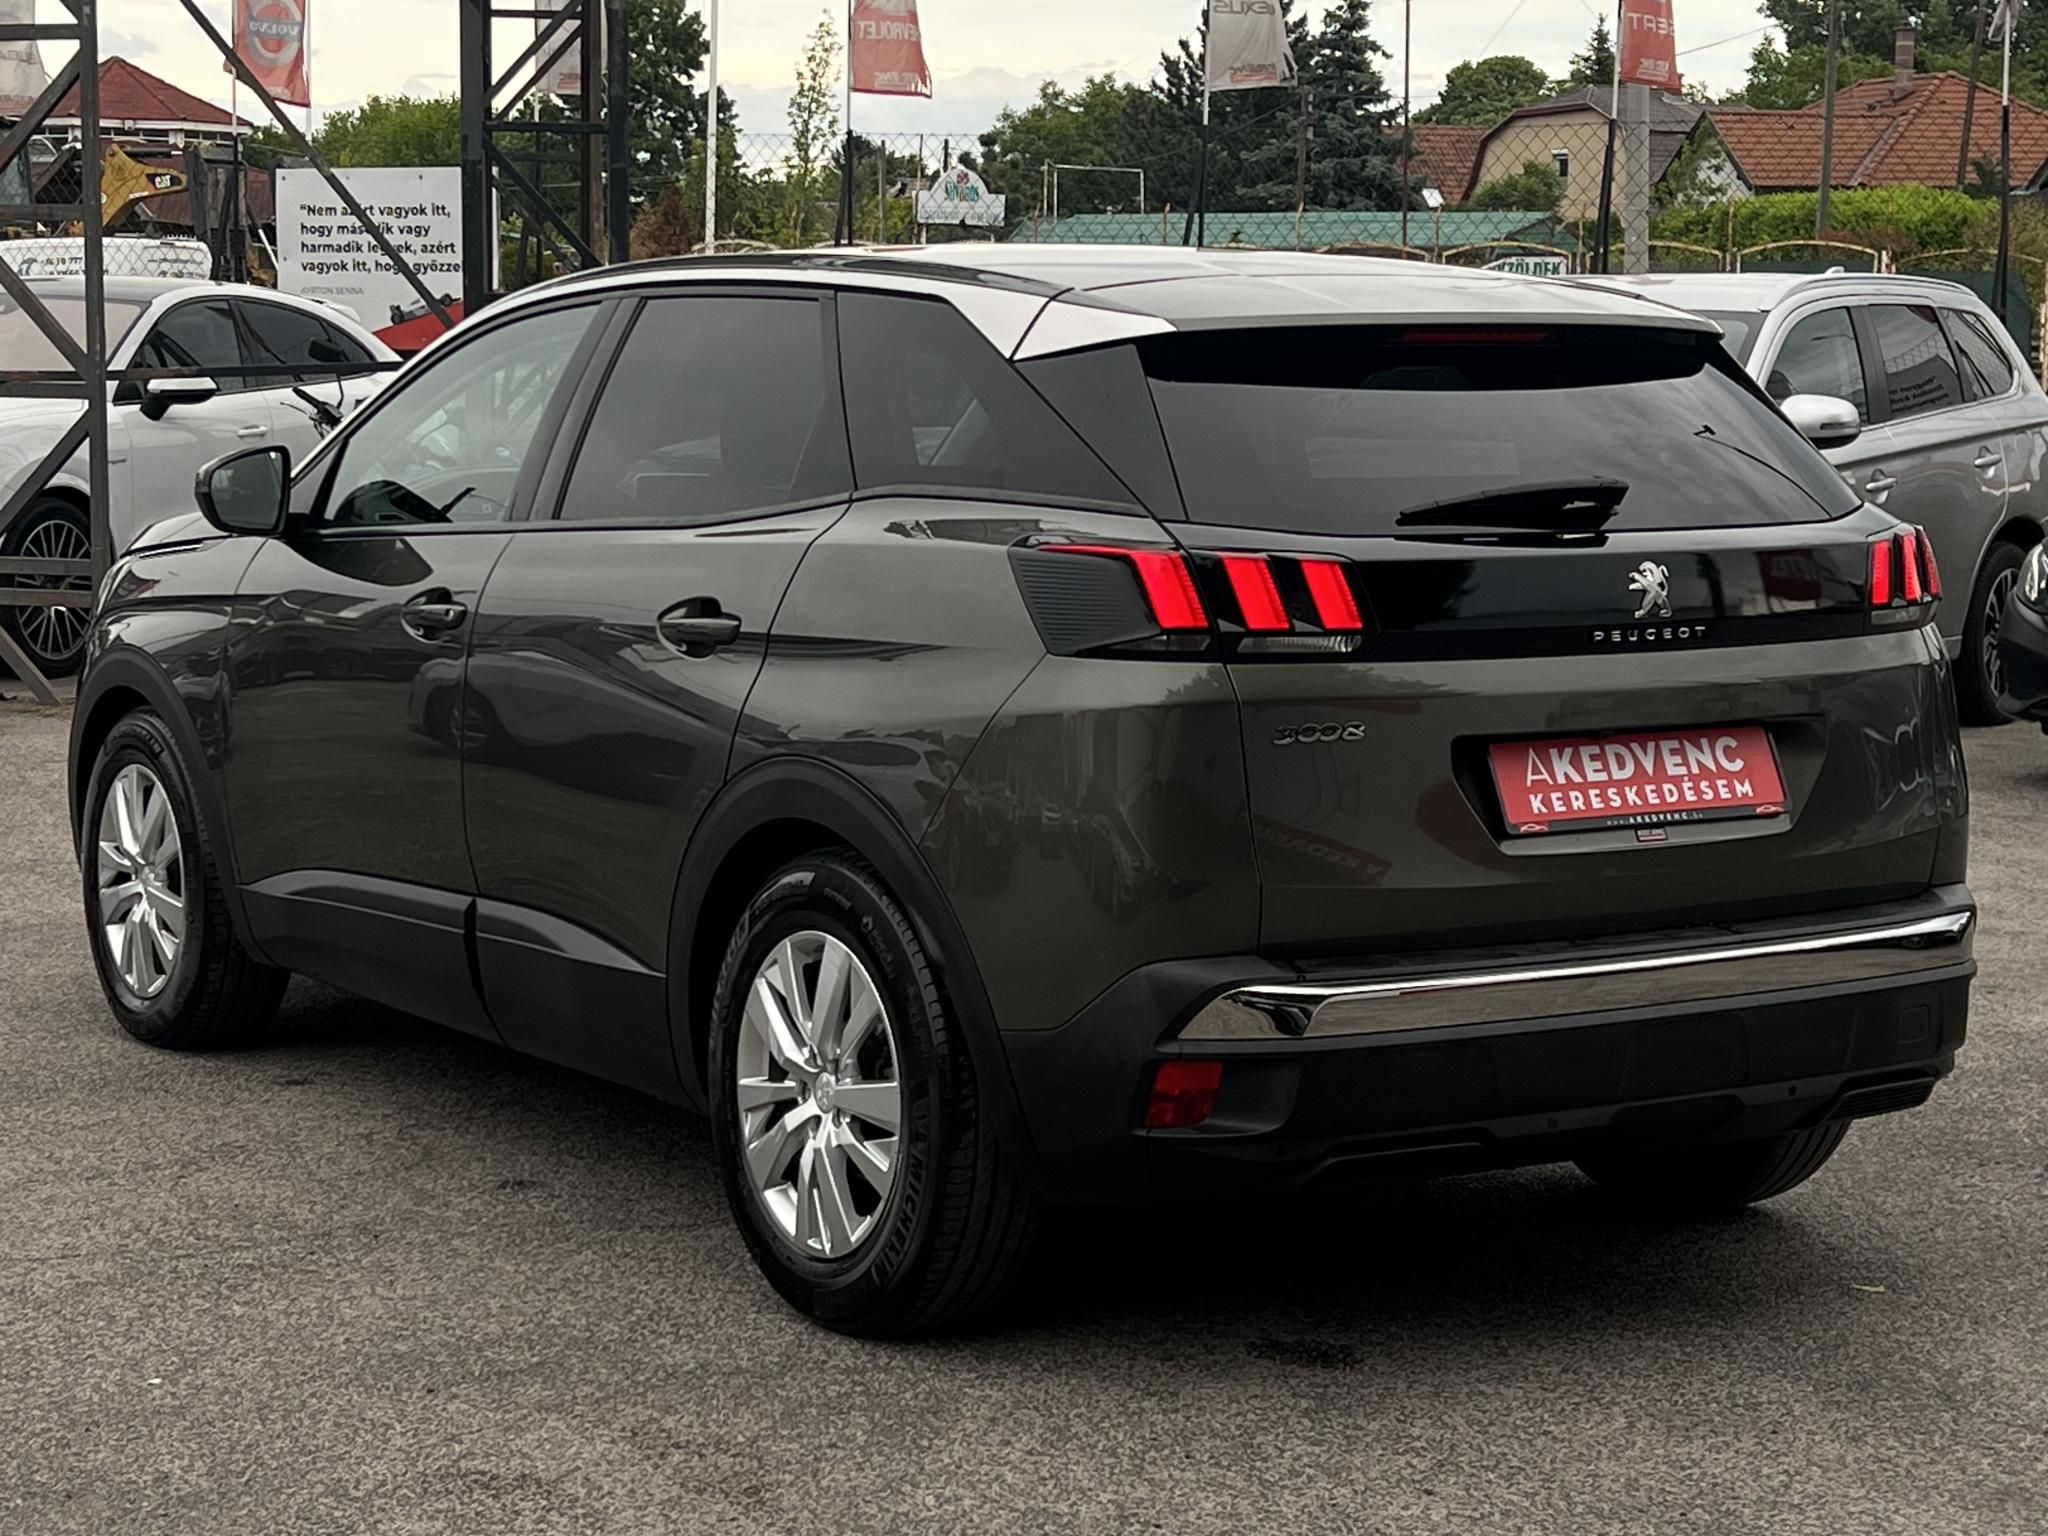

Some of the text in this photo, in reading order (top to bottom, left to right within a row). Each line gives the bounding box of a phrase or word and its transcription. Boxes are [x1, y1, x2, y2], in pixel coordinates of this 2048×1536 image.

[378, 203, 427, 219] vagyok
[301, 222, 430, 237] hogy másik vagy
[301, 240, 456, 256] harmadik legek, azért
[301, 260, 349, 275] vagyok
[375, 260, 400, 275] hog
[413, 260, 461, 275] győzze
[1593, 626, 1706, 642] PEUGEOT
[1273, 721, 1366, 745] 3008
[1526, 736, 1745, 787] AKEDVENC
[1529, 776, 1754, 815] KERESKEDÉSEM
